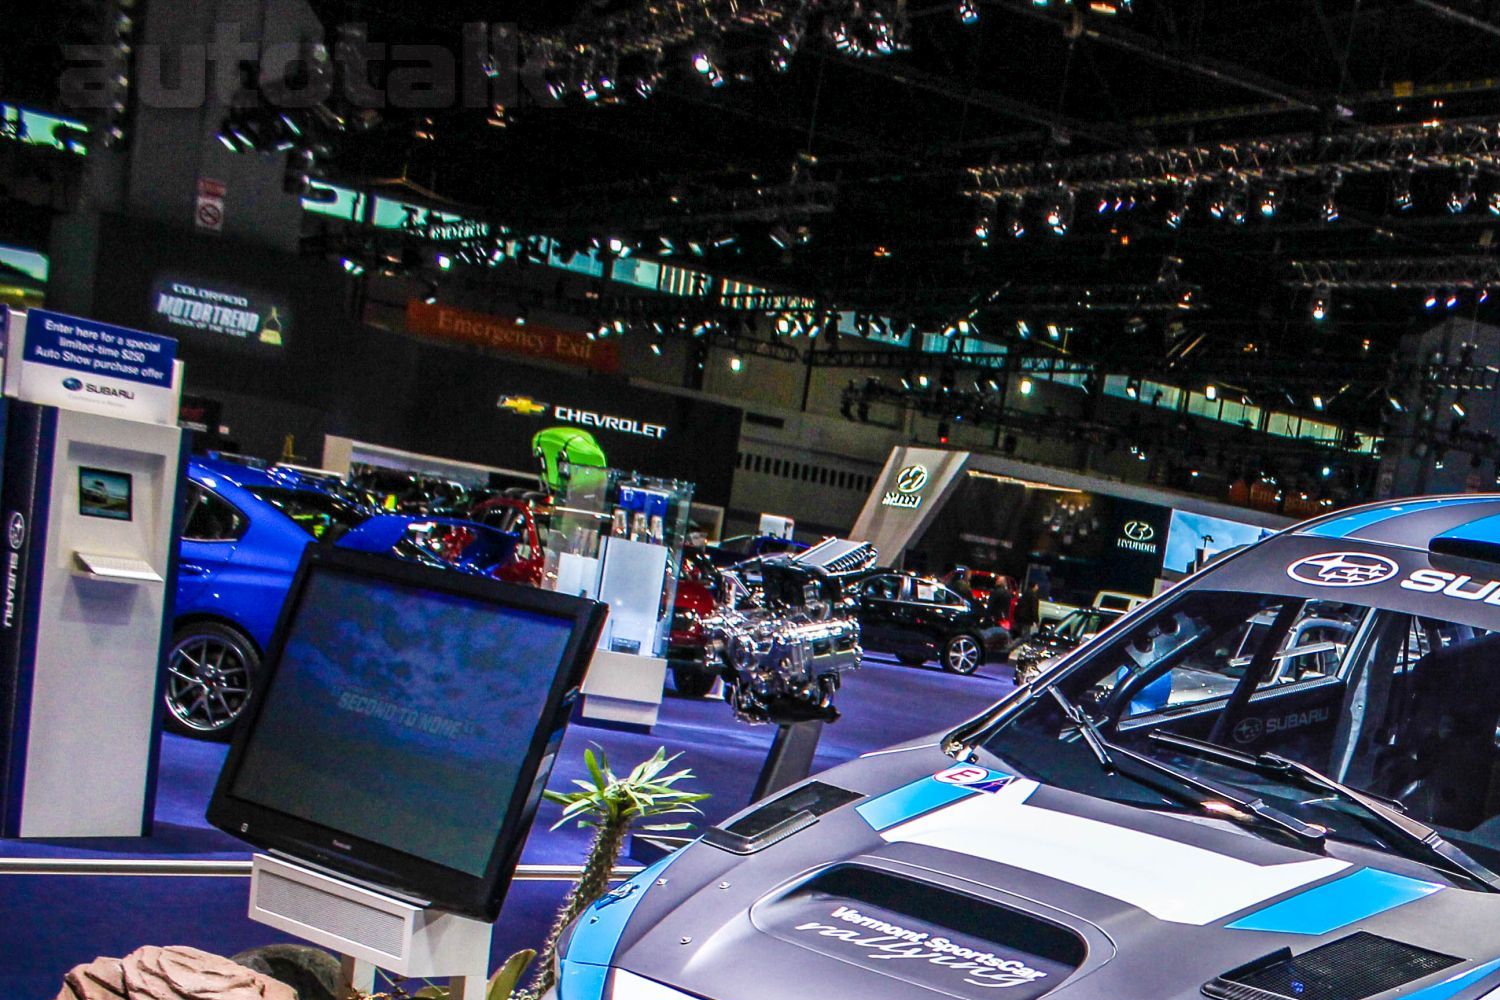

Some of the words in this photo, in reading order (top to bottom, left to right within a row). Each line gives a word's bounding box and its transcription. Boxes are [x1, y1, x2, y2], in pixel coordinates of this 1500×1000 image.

[44, 319, 73, 334] Enter
[75, 326, 99, 341] here
[101, 331, 116, 343] for
[126, 338, 160, 352] special
[59, 337, 119, 358] limited-time
[437, 309, 546, 351] Emergency
[555, 333, 592, 360] Exit
[35, 345, 60, 360] Auto
[62, 351, 91, 366] Show
[93, 359, 139, 375] purchase
[141, 367, 164, 380] offer
[85, 383, 135, 400] SUBARU
[554, 405, 667, 440] CHEVROLET
[3, 552, 19, 628] SUBARU
[1266, 707, 1329, 734] SUBARU
[795, 921, 1036, 988] rallying
[831, 906, 929, 943] Vermont
[923, 936, 1047, 980] SportsCar
